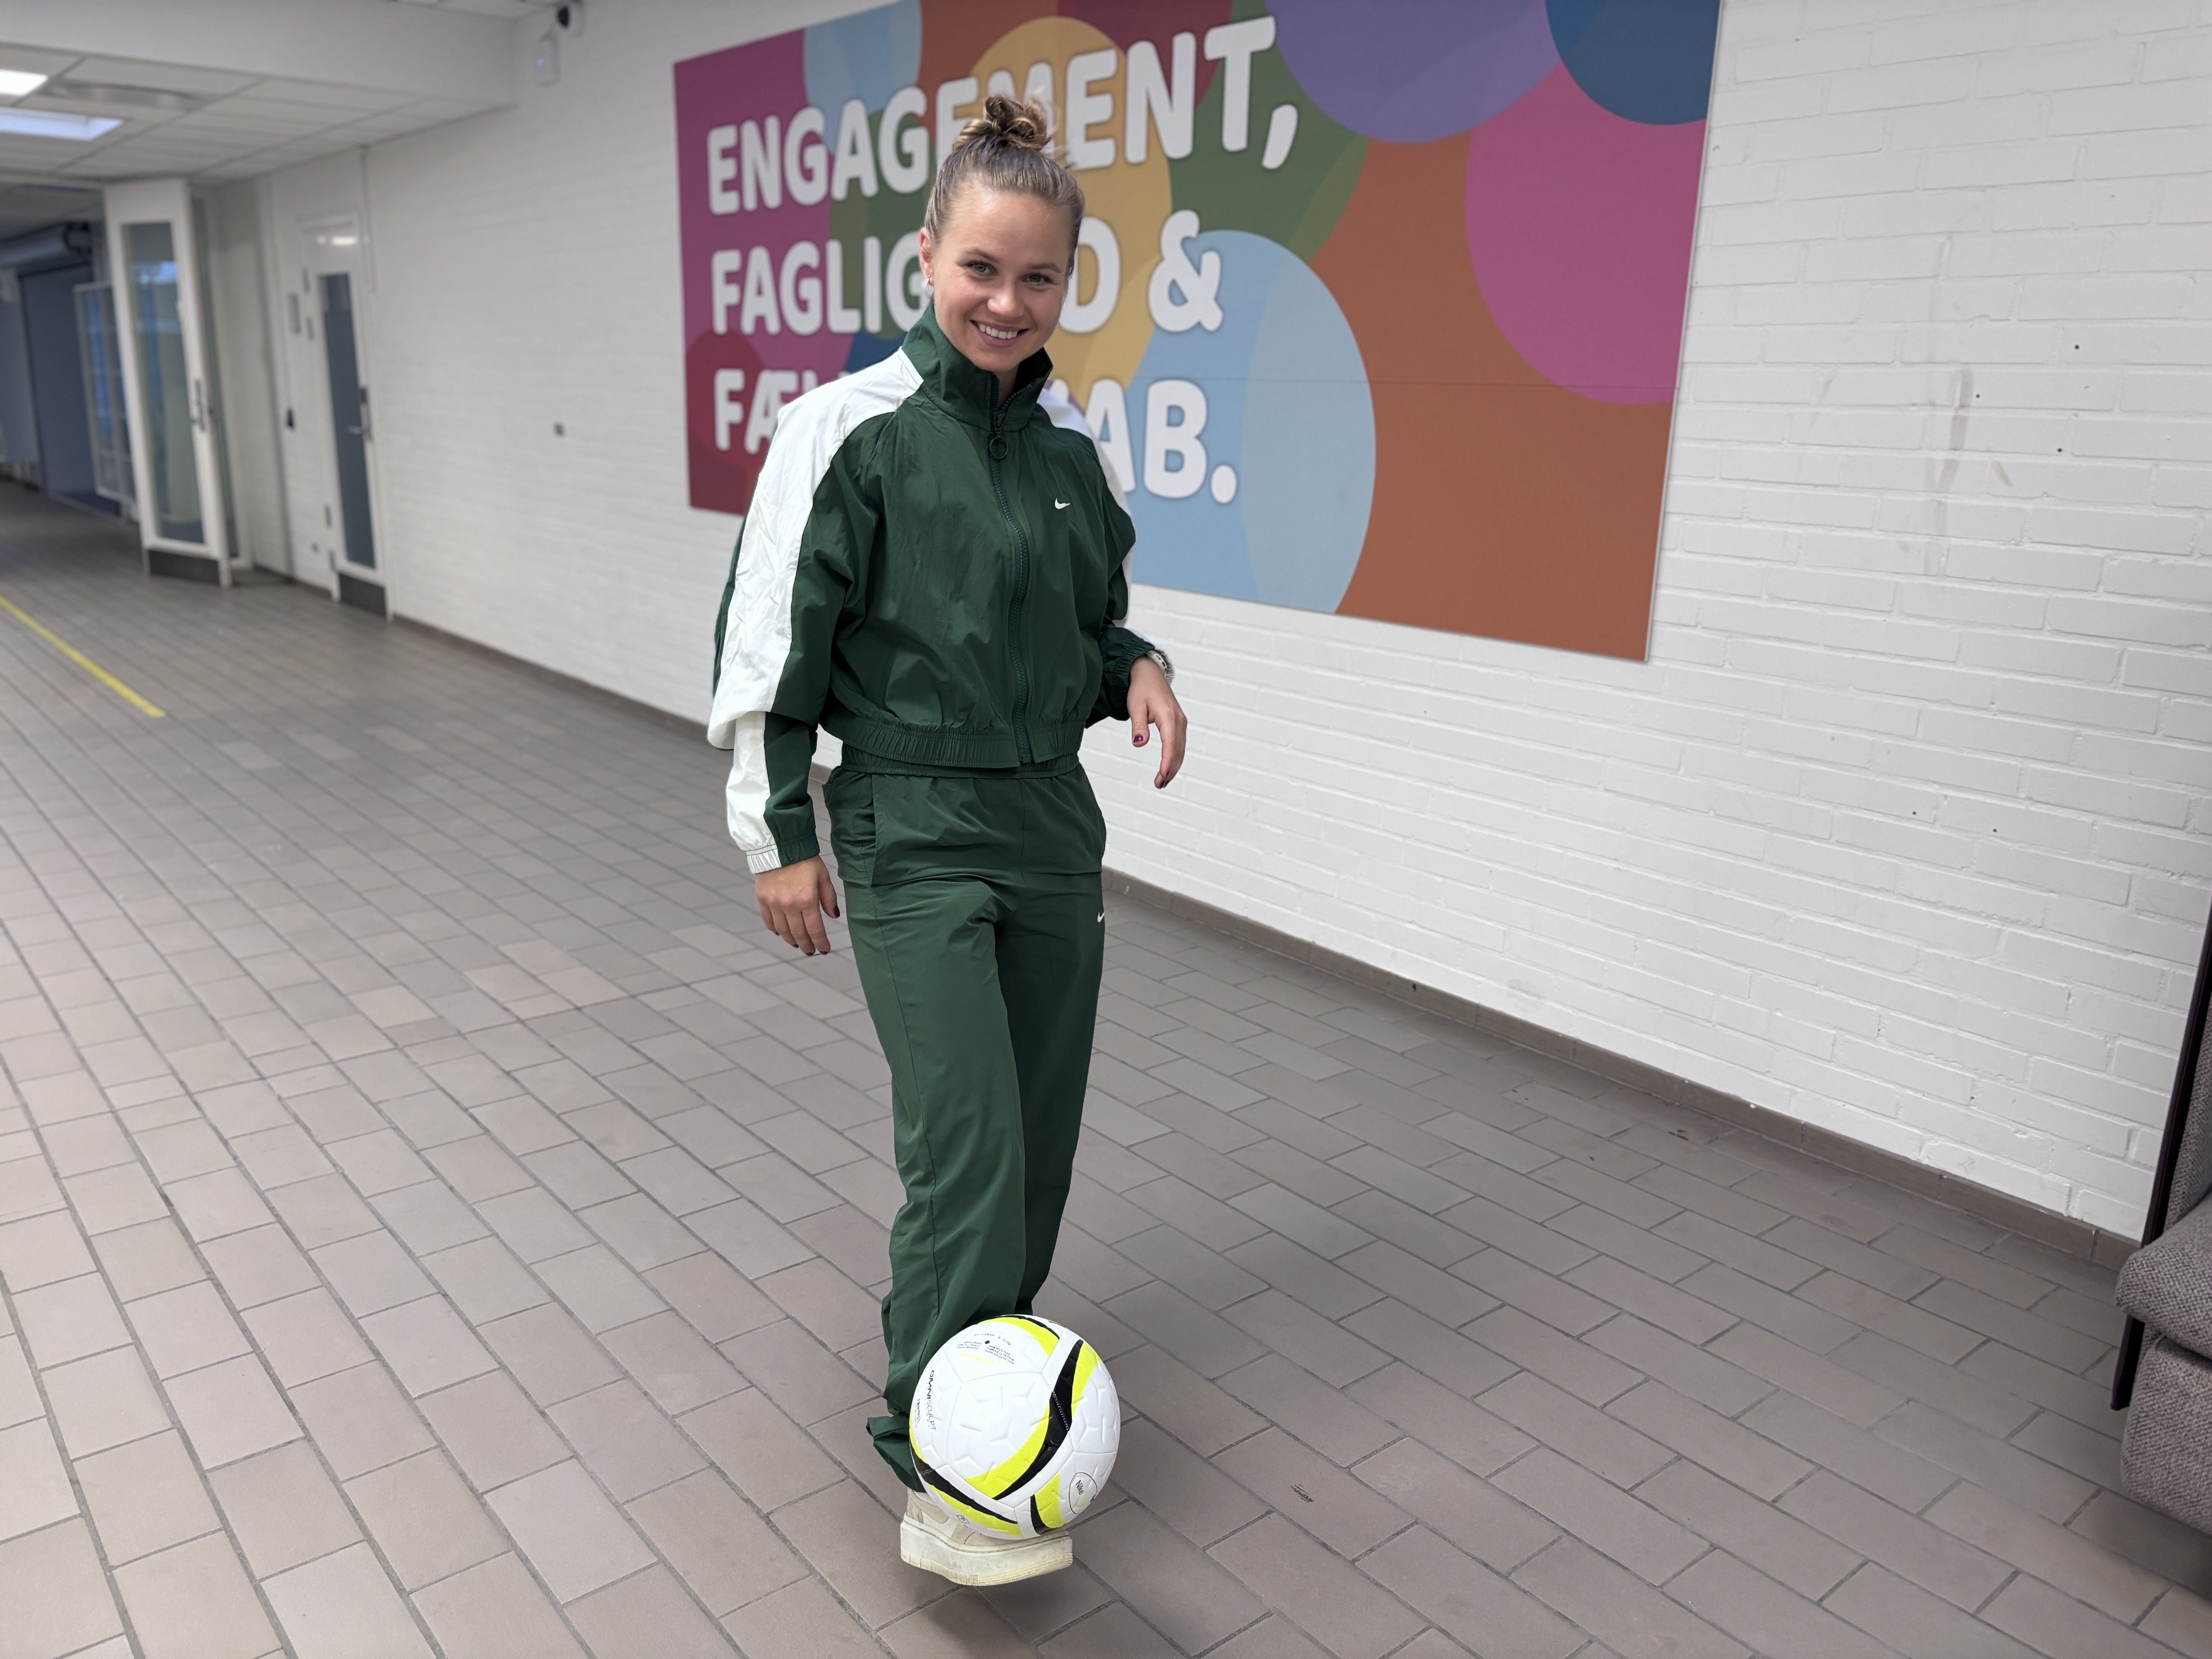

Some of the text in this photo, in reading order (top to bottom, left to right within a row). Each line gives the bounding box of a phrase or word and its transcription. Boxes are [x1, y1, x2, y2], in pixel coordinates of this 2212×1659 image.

[711, 210, 1223, 336] FAGLIGD &
[927, 1370, 936, 1431] OMNISCULPT
[1075, 1480, 1084, 1495] Nike
